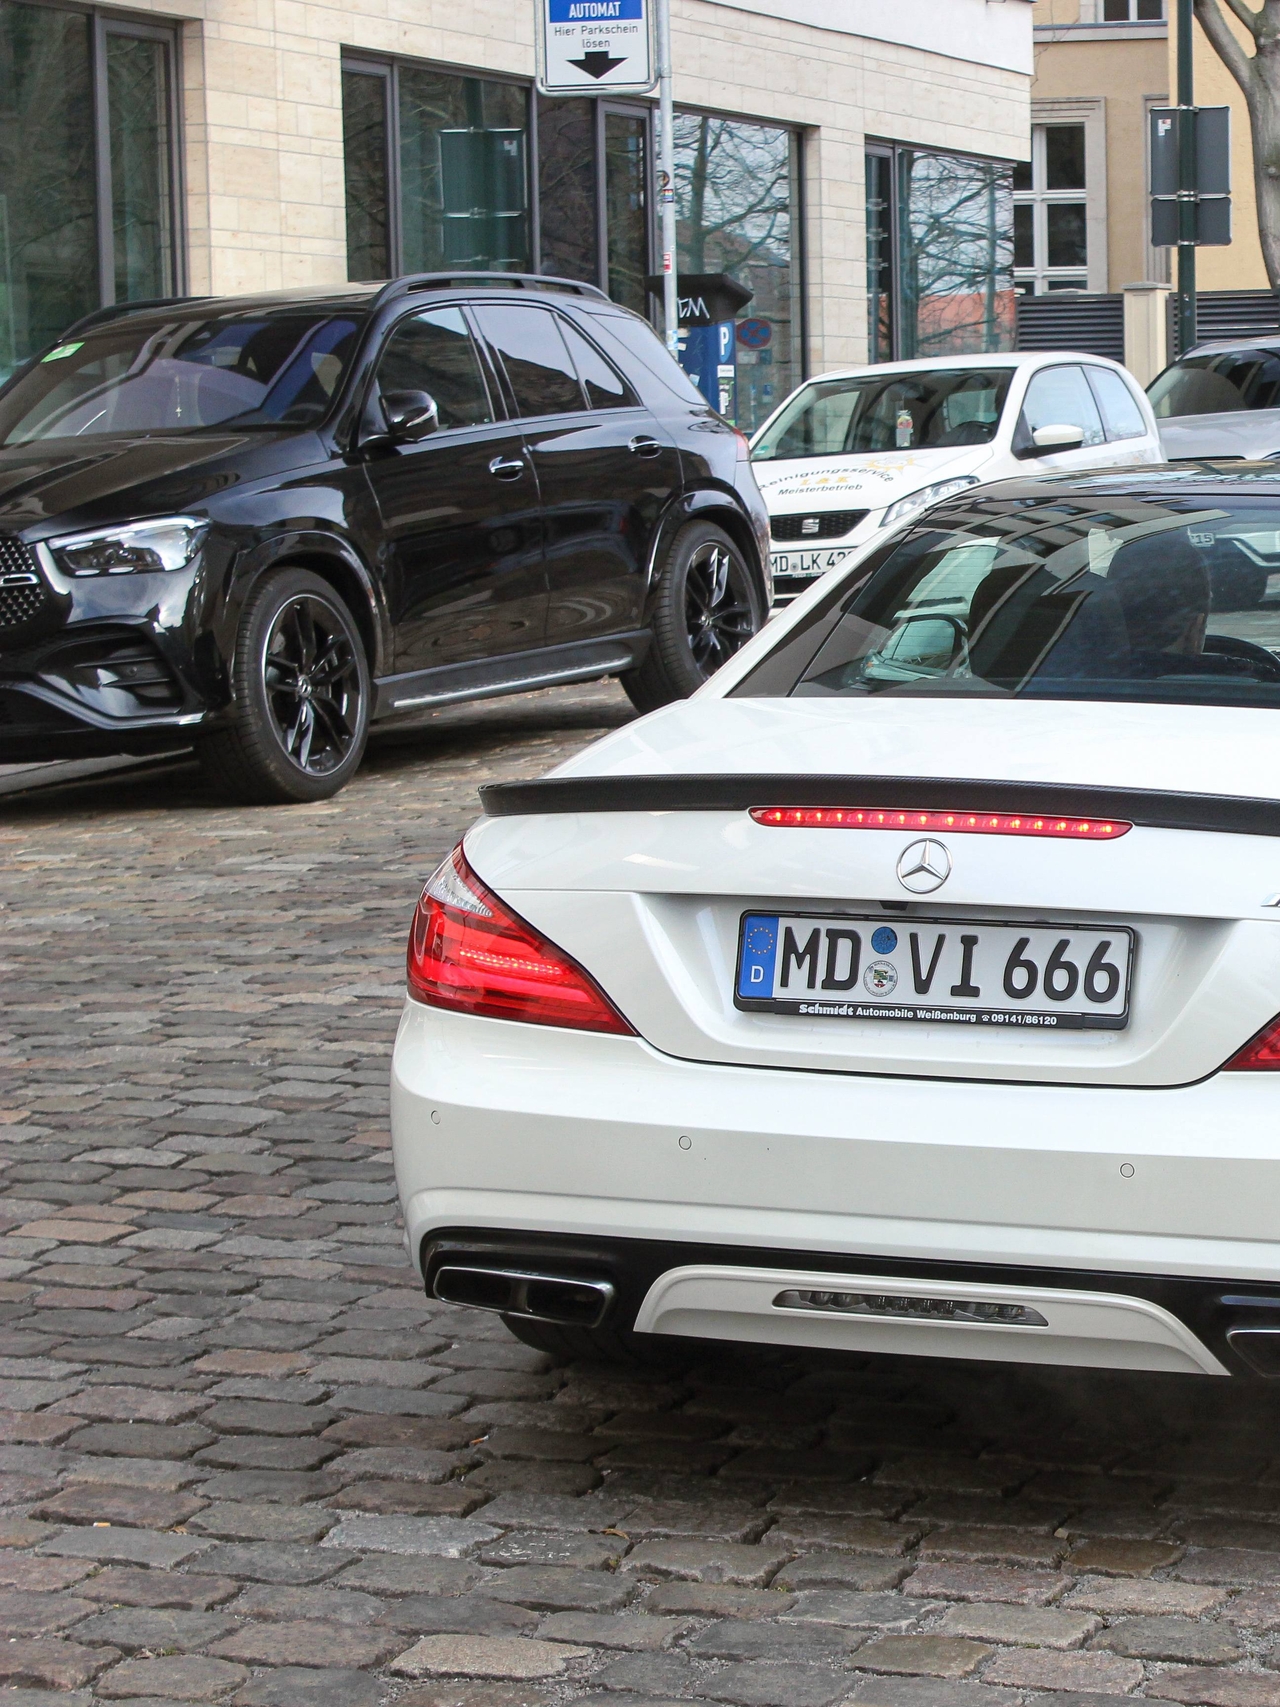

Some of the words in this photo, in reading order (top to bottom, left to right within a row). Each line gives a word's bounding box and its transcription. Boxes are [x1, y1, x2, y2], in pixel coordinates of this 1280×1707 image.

[569, 2, 621, 19] AUTOMAT
[554, 27, 576, 37] Hier
[581, 24, 639, 36] Parkschein
[582, 38, 611, 49] lösen
[778, 484, 863, 496] Meisterbetrieb
[770, 555, 789, 573] MD
[801, 553, 822, 571] LK
[827, 551, 854, 569] 42
[750, 966, 764, 982] D
[780, 926, 862, 990] MD
[909, 932, 981, 998] VI
[1003, 937, 1120, 1003] 666
[799, 1002, 854, 1016] Schmidt
[856, 1007, 914, 1019] Automobile
[916, 1009, 977, 1023] Weißenburg
[991, 1014, 1058, 1026] 09141/86120
